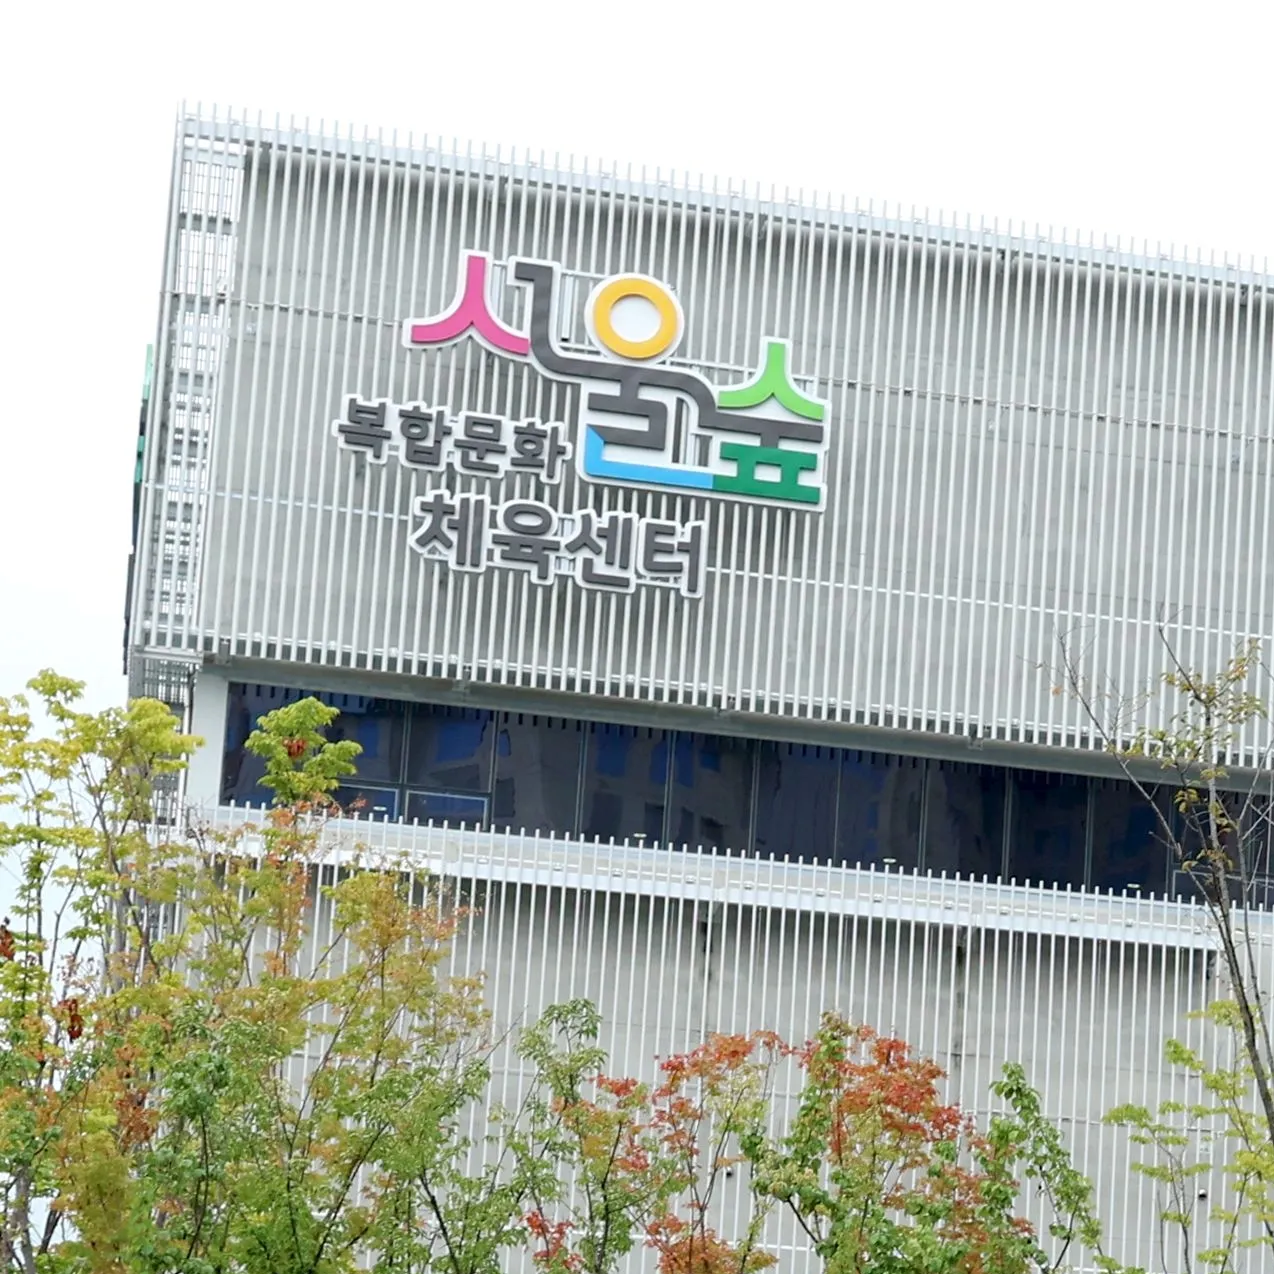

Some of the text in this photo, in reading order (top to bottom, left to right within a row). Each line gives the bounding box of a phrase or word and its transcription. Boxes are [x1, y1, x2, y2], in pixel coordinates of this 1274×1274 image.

[410, 254, 825, 505] 서울숲
[338, 398, 567, 479] 복합문화
[415, 494, 703, 594] 체육센터
